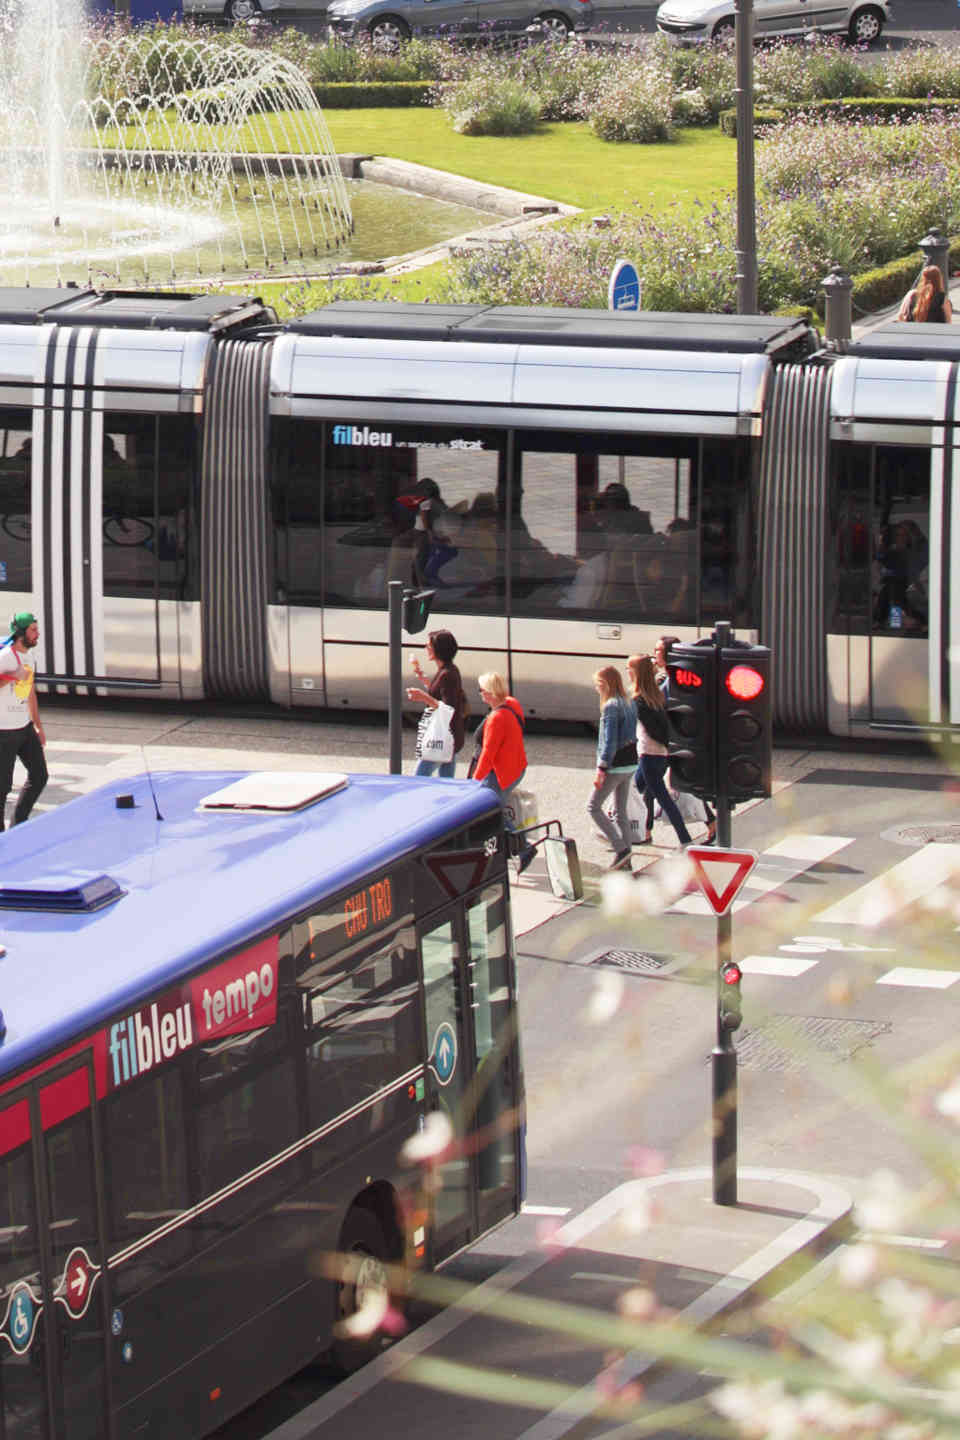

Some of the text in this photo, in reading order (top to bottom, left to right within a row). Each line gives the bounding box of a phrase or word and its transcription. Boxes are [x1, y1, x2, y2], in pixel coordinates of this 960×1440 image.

[333, 424, 392, 447] filbleu
[676, 669, 702, 688] BUS
[344, 890, 369, 939] CHU
[202, 962, 274, 1031] tempo
[109, 1002, 193, 1087] filbleu
